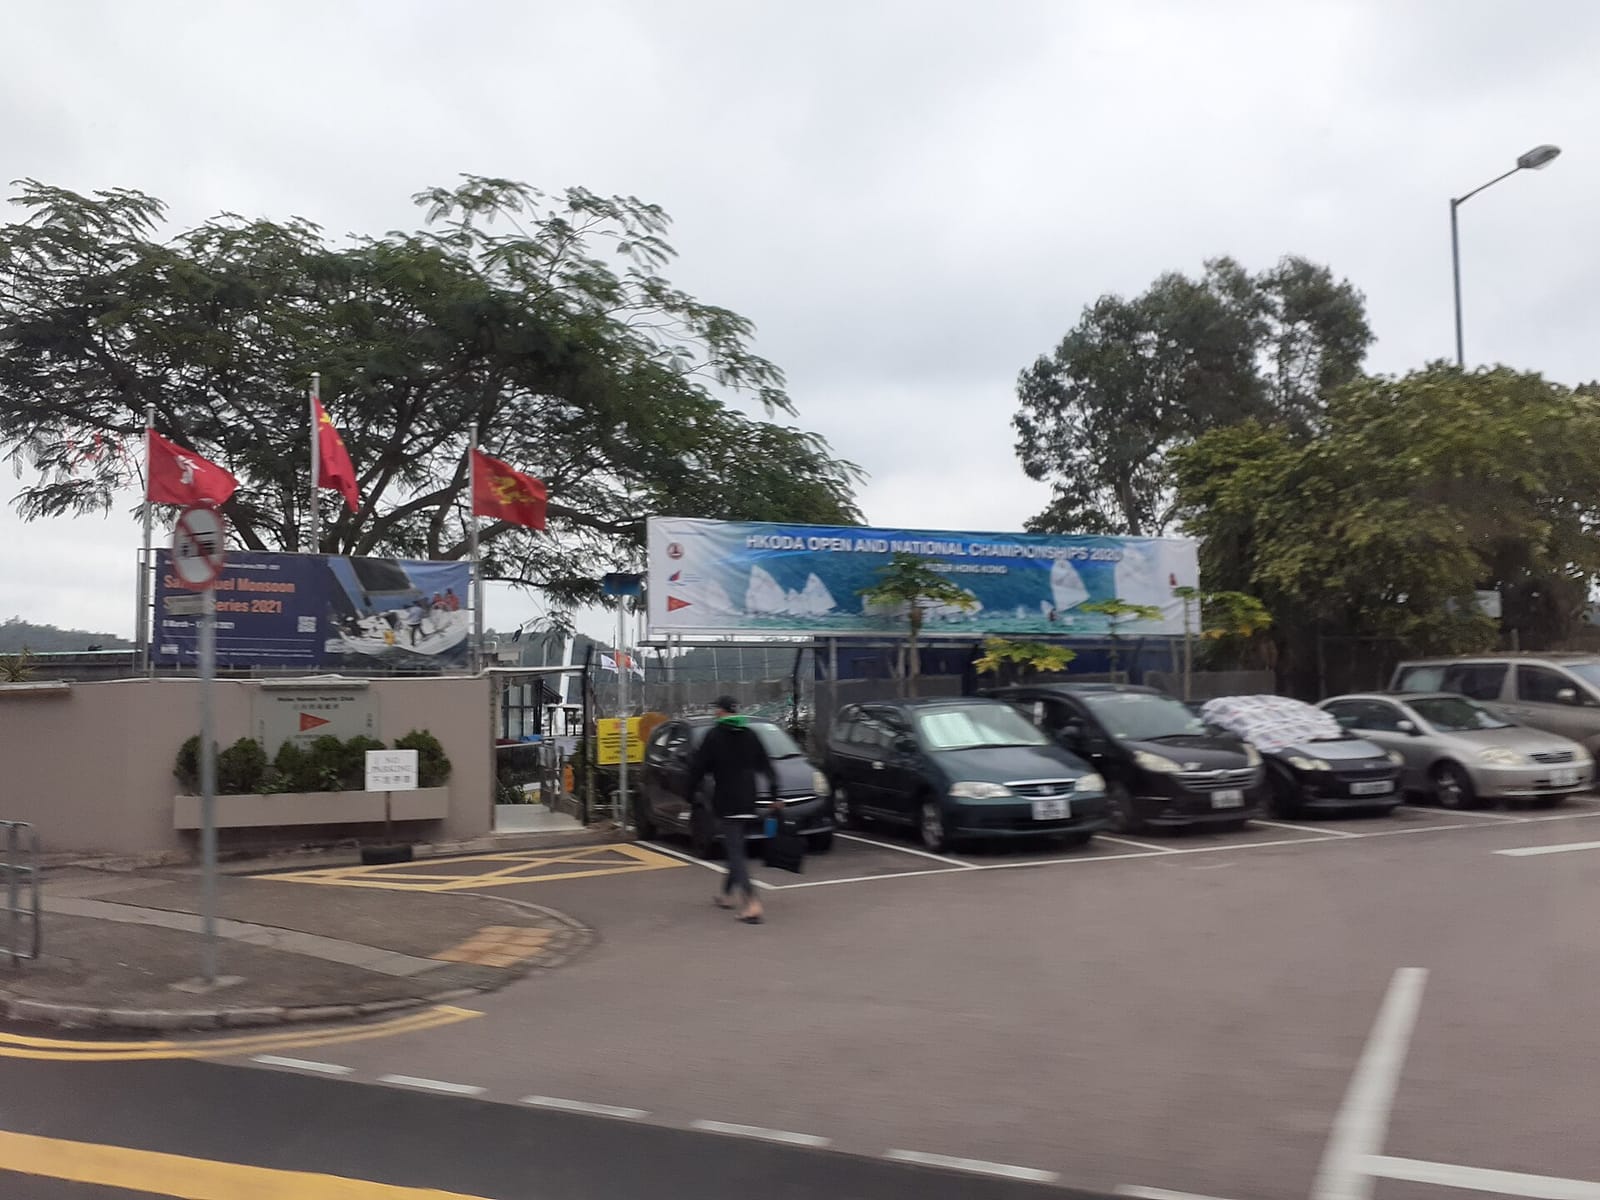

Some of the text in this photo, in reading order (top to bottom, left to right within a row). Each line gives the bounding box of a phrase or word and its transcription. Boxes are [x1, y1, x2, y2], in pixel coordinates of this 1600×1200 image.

[746, 535, 804, 550] HKODA
[807, 537, 851, 551] OPEN
[854, 539, 888, 552] AND
[891, 540, 967, 556] NATIONAL
[969, 543, 1088, 560] CHAMPIONSHIPS
[956, 564, 979, 573] HONG
[981, 565, 1008, 574] KONG
[237, 577, 295, 593] Monsoon
[251, 600, 282, 613] 2021
